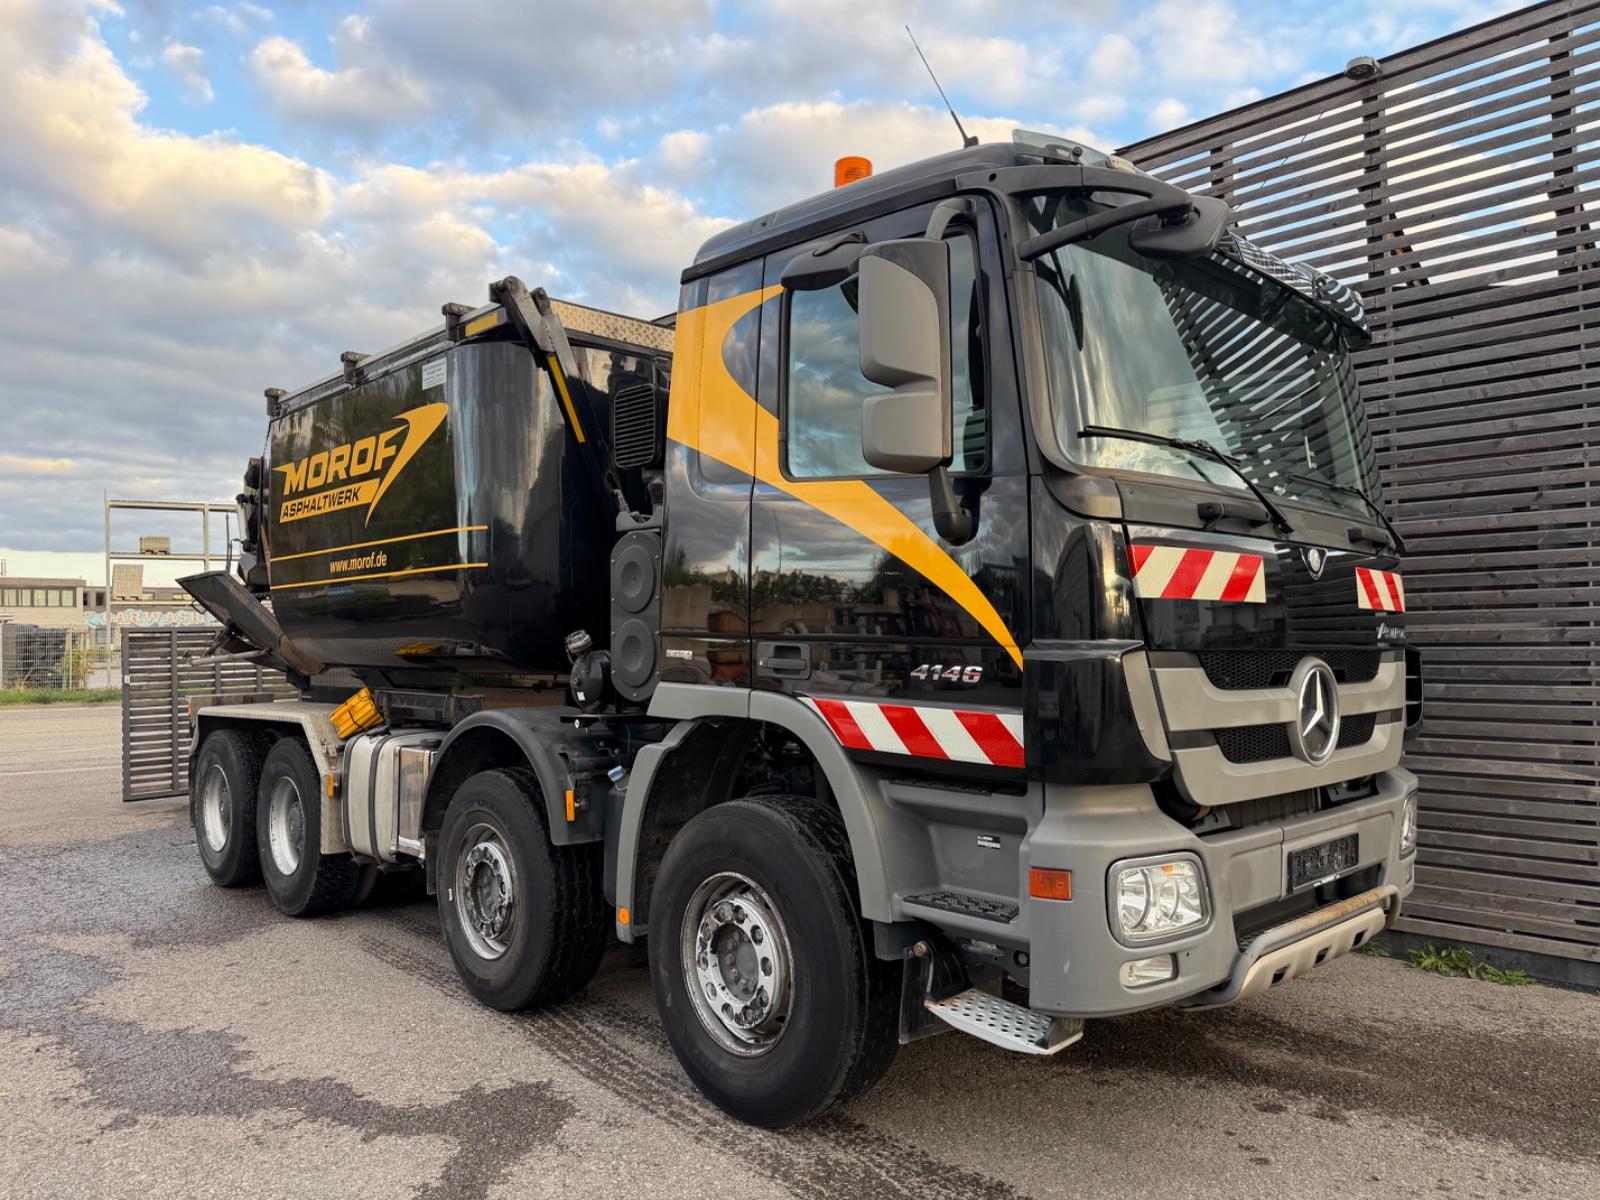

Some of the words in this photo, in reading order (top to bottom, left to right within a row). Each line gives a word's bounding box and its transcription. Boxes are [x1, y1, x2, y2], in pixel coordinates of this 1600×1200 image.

[272, 424, 408, 496] MOROF
[282, 486, 362, 519] ASPHALTWERK
[329, 550, 388, 573] www.morof.de
[910, 664, 983, 682] 4146
